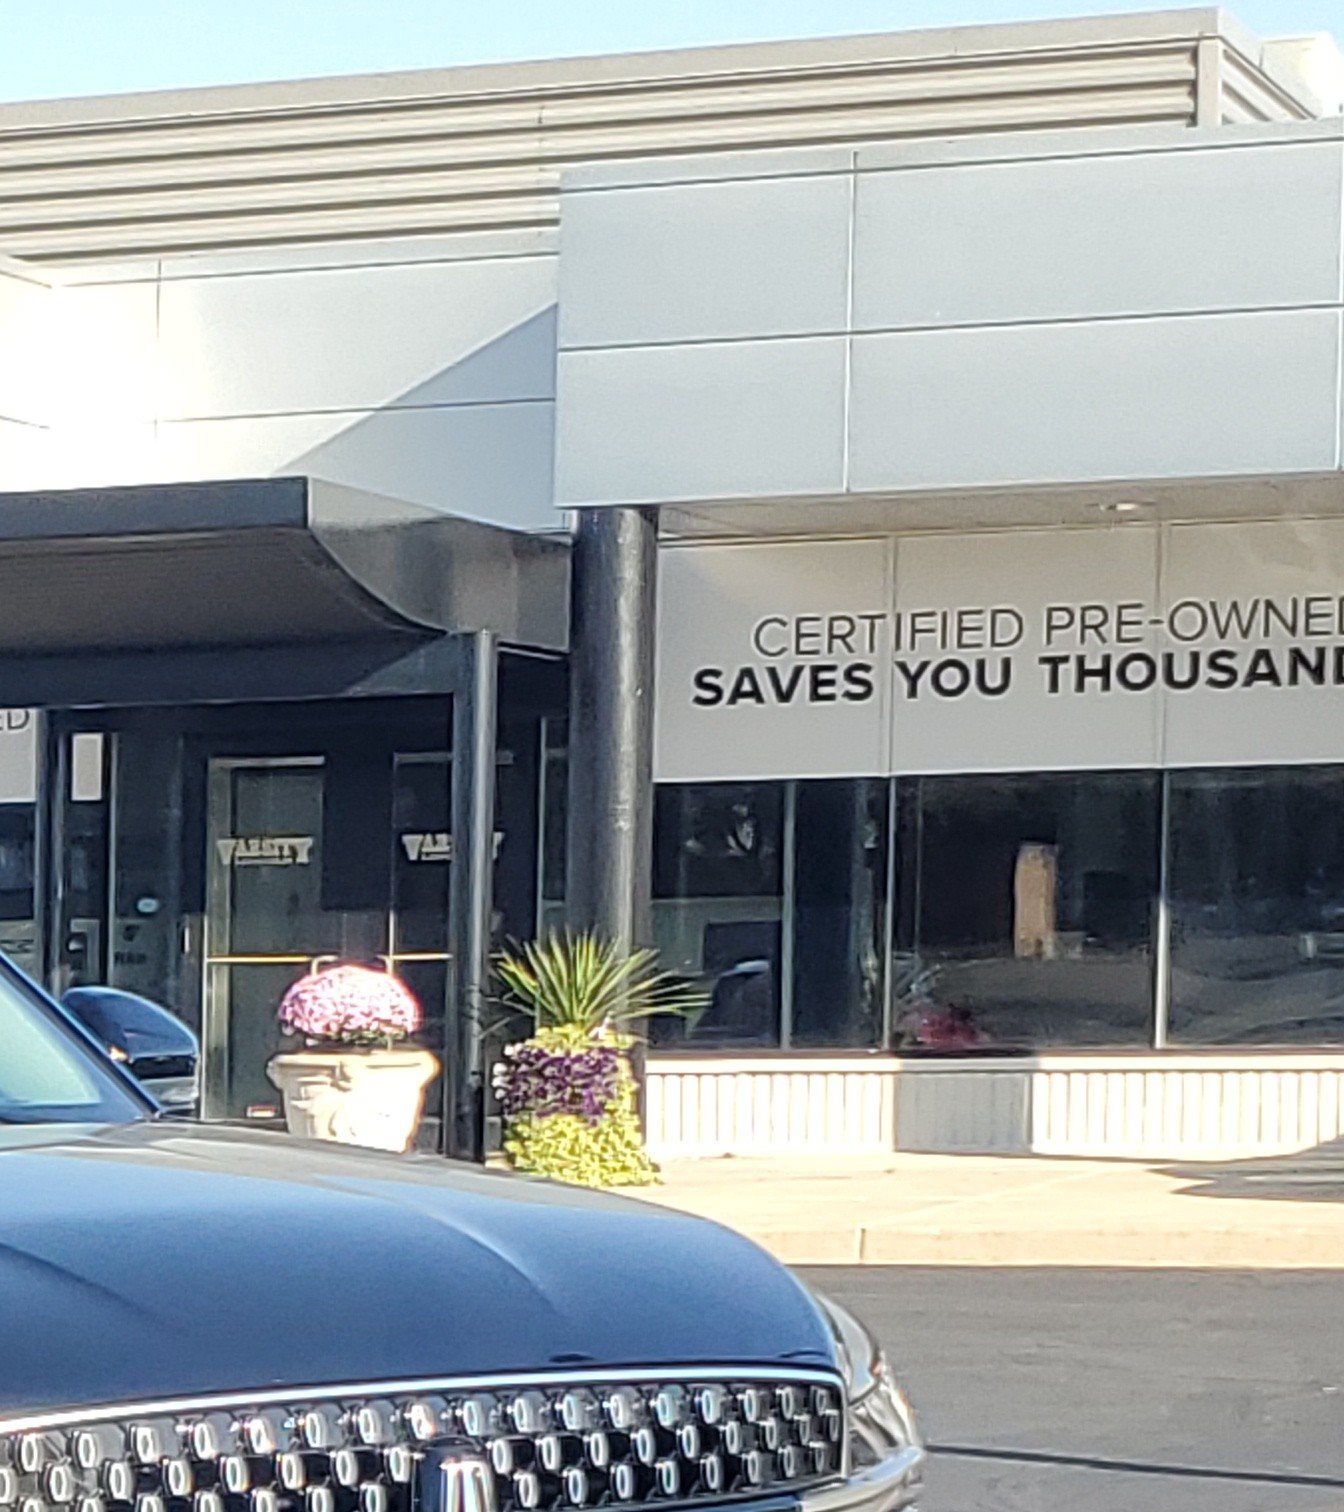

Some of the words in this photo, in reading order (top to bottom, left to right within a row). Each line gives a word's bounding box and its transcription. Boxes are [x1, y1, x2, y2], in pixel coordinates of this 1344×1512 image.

[753, 608, 1023, 658] CERTIFIED
[1045, 596, 1344, 646] PRE-OWNE
[691, 660, 874, 706] SAVES
[894, 656, 1012, 700] YOU
[1038, 646, 1344, 694] THOUSAN
